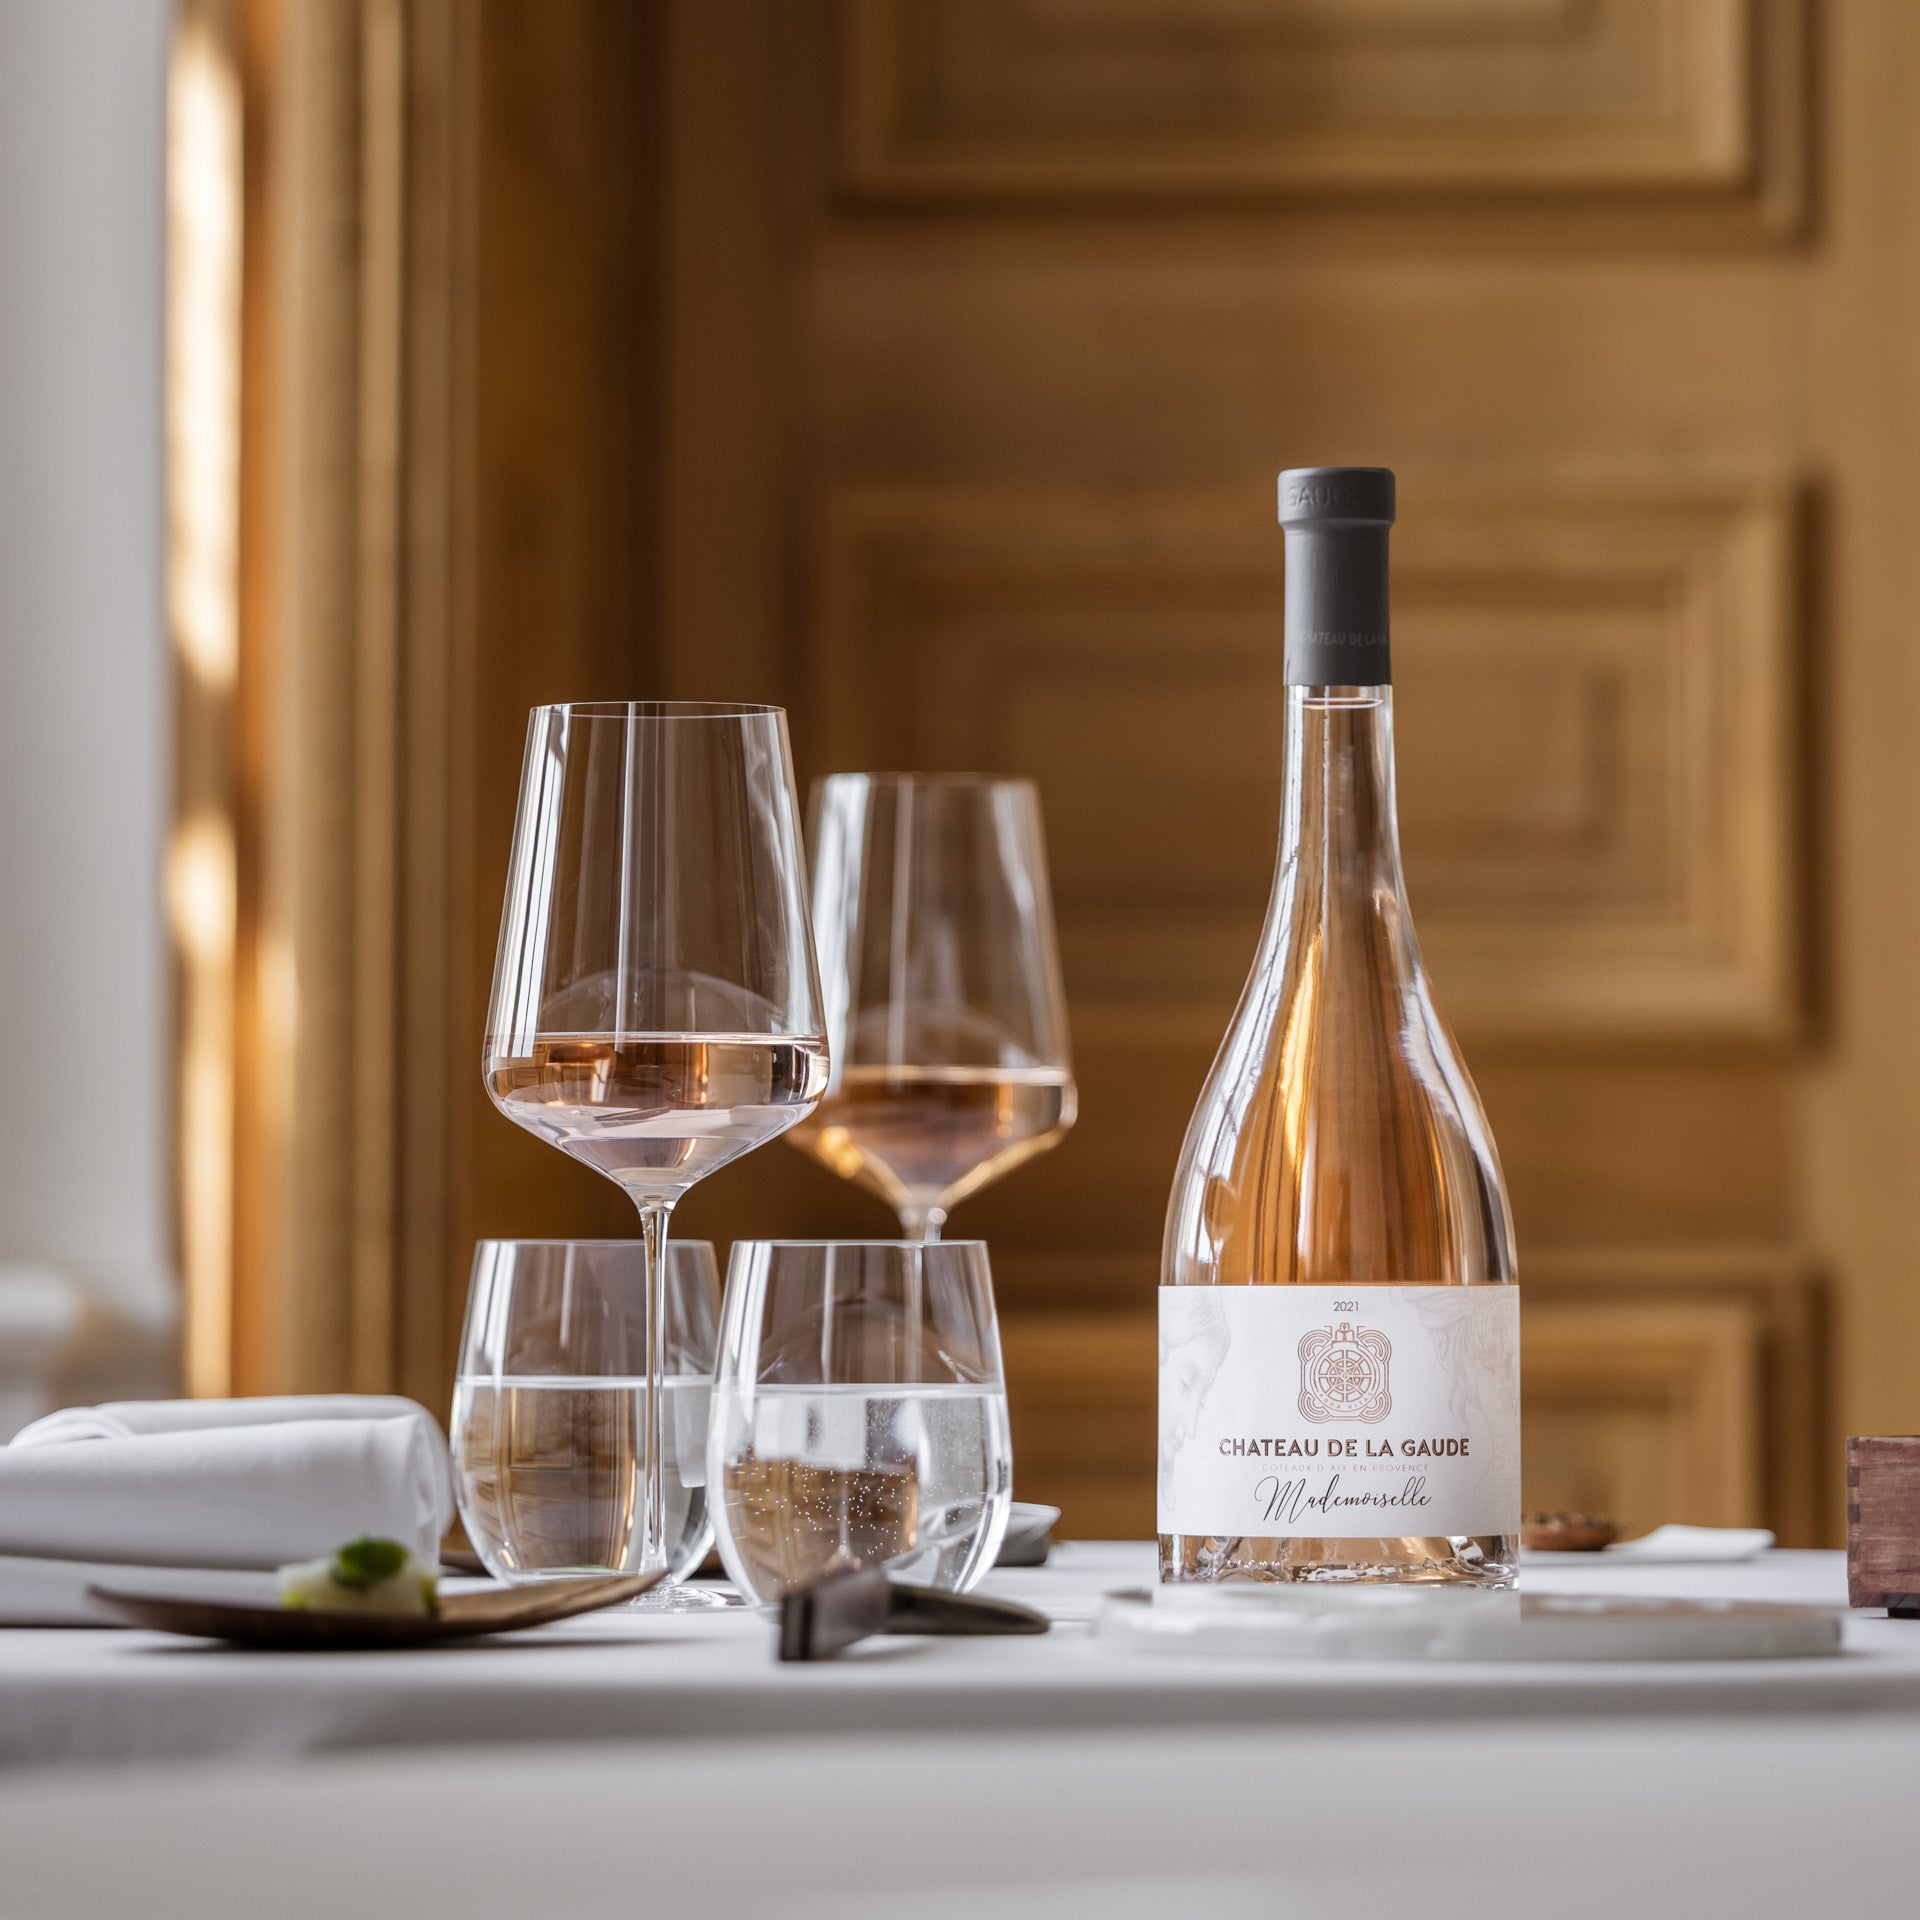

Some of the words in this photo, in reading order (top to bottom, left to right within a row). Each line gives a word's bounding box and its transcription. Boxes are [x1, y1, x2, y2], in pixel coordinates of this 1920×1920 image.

[1286, 485, 1361, 509] GAUD
[1333, 1301, 1359, 1311] 2021
[1218, 1438, 1319, 1457] CHATEAU
[1327, 1438, 1357, 1457] DE
[1366, 1438, 1394, 1457] LA
[1401, 1438, 1470, 1457] GAUDE
[1262, 1463, 1312, 1472] COTEAUX
[1353, 1463, 1367, 1472] EN
[1373, 1463, 1429, 1472] PROVENCE
[1254, 1474, 1432, 1524] Mademoiselle
